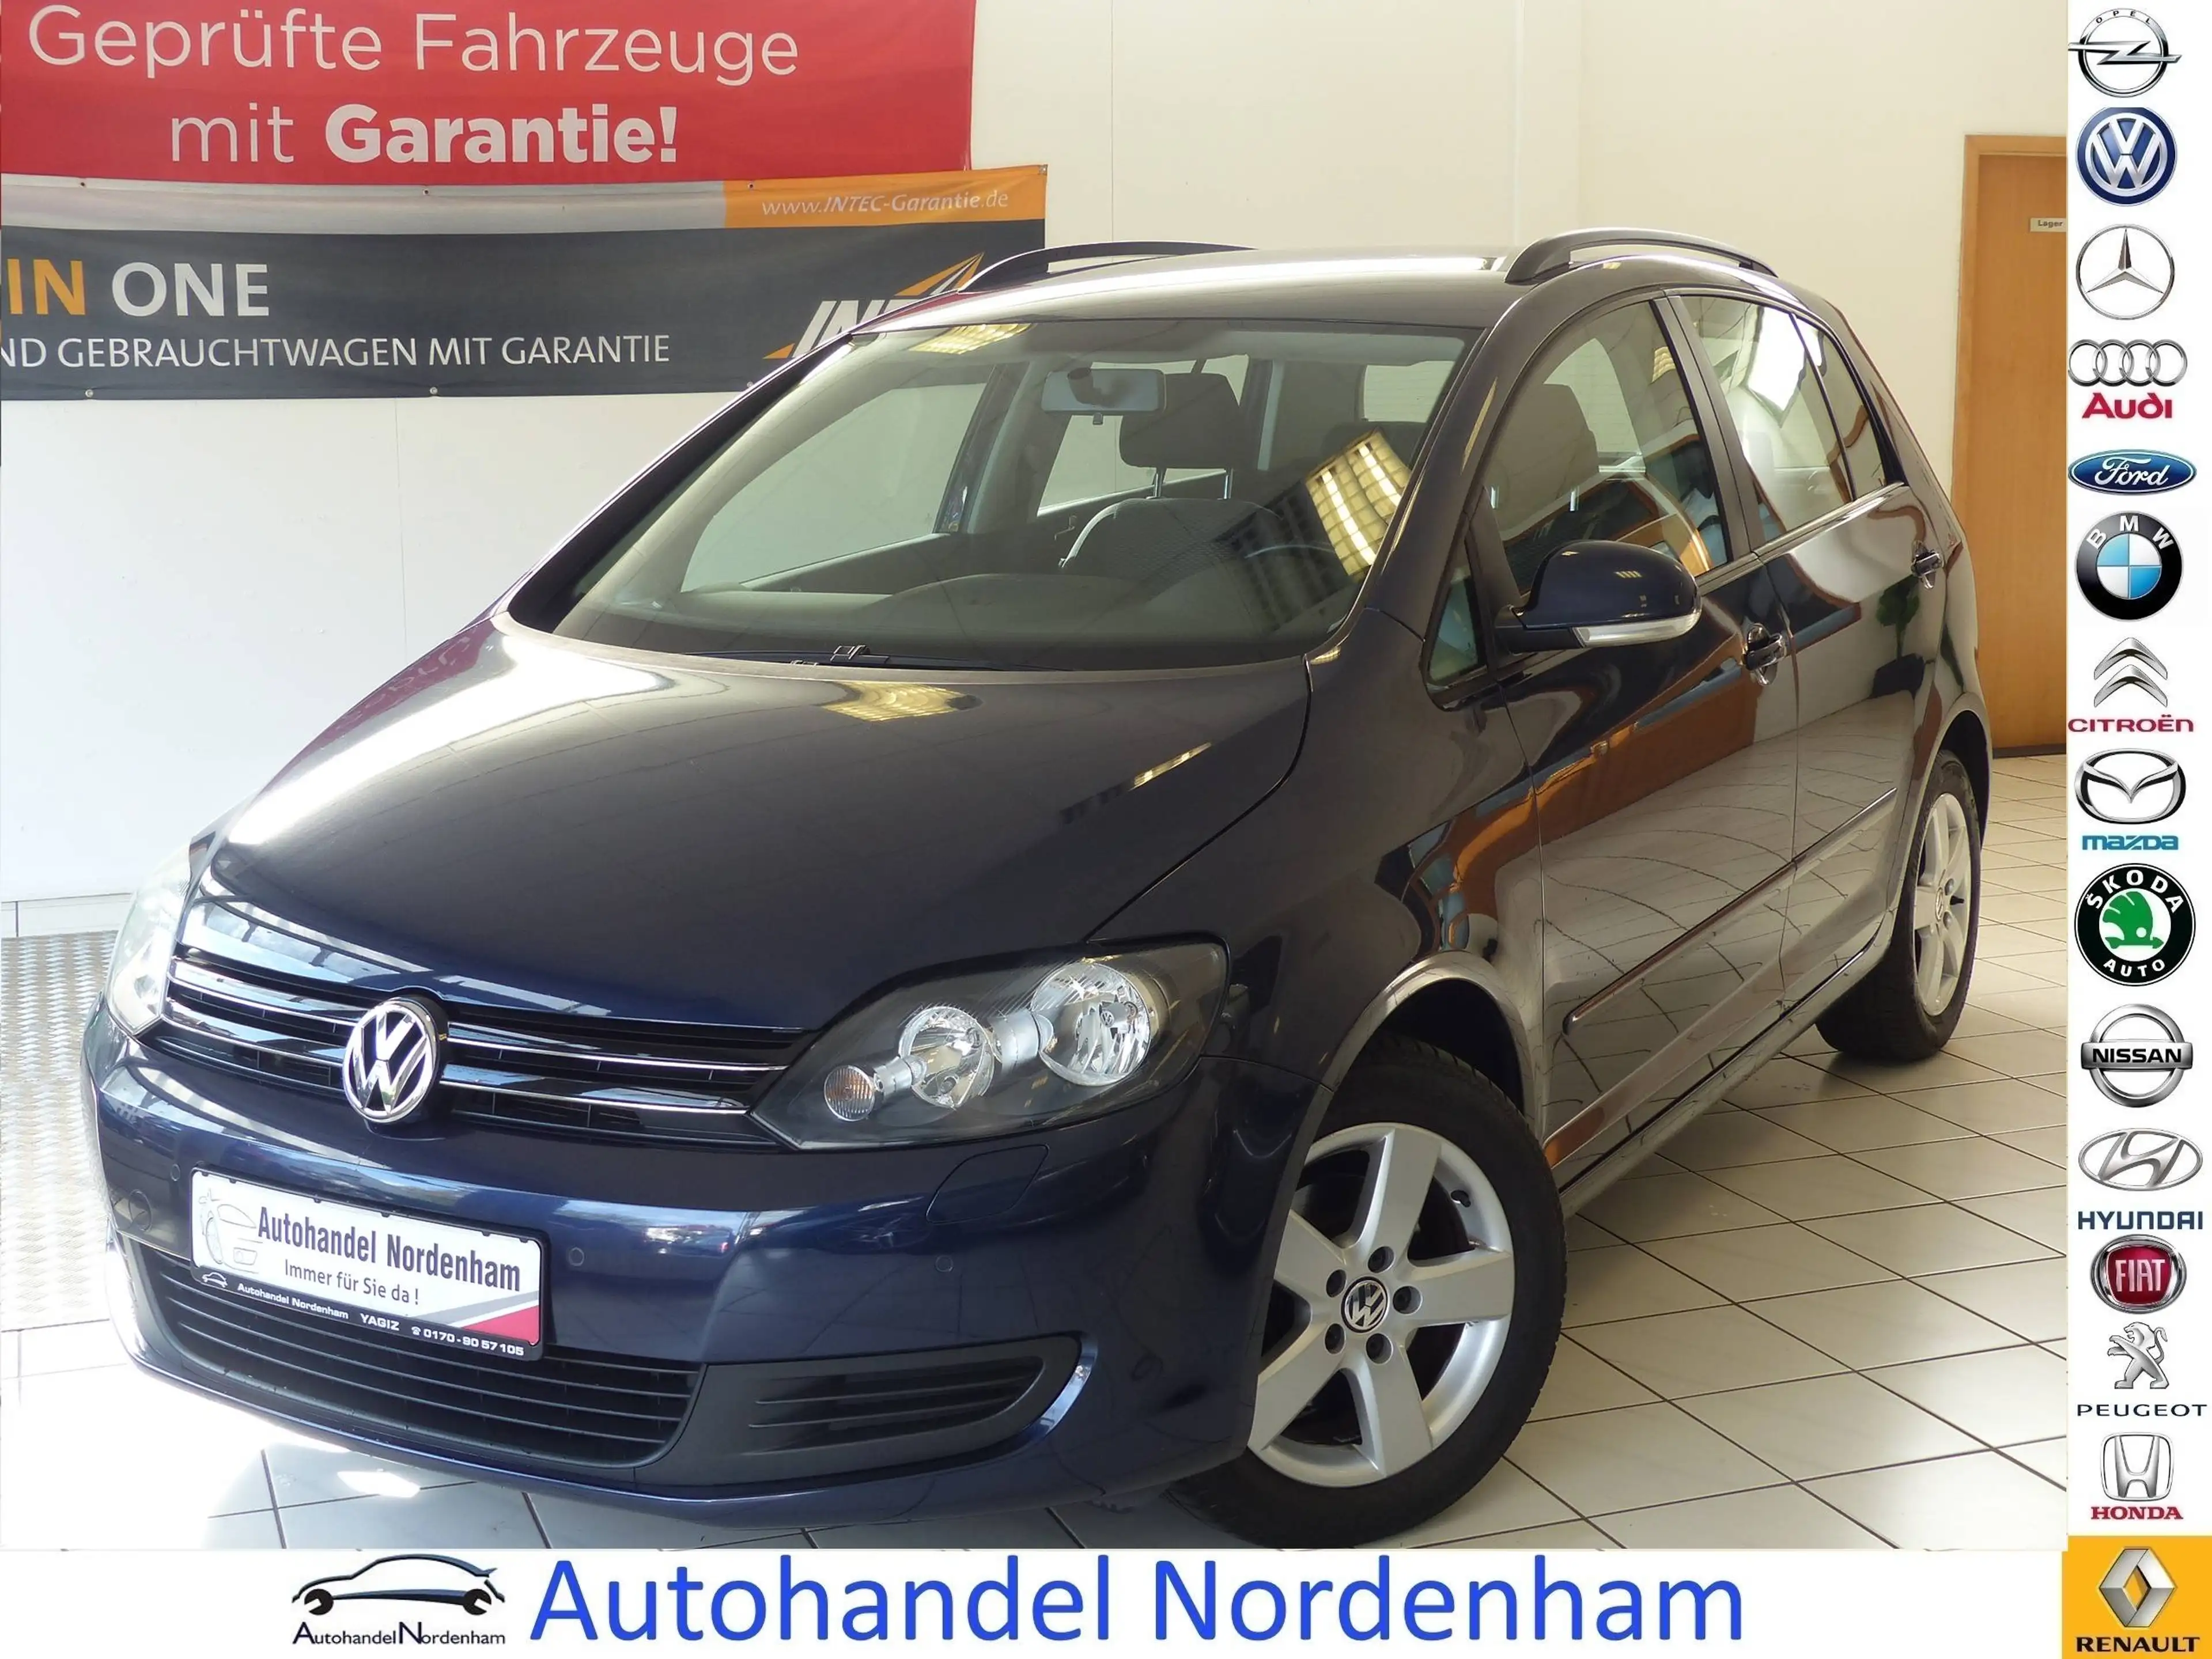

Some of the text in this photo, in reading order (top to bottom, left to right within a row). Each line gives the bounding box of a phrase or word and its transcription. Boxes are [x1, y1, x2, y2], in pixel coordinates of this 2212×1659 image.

[29, 5, 798, 86] Geprüfte Fahrzeuge
[172, 103, 678, 164] mit Garantie!
[762, 190, 1008, 215] www.INTEC-Garantie.de
[2037, 219, 2063, 228] Lager
[7, 259, 269, 317] IN ONE
[58, 337, 417, 368] GEBRAUCHTWAGEN
[429, 337, 493, 366] MIT
[502, 335, 670, 365] GARANTIE
[257, 1206, 520, 1292] Autohandel Nordenham
[285, 1259, 332, 1286] Immer
[336, 1271, 358, 1291] für
[363, 1277, 387, 1298] Sie
[391, 1284, 410, 1303] da
[237, 1282, 289, 1305] Autohandel
[292, 1297, 349, 1320] Nordenham
[360, 1313, 400, 1331] YAGIZ
